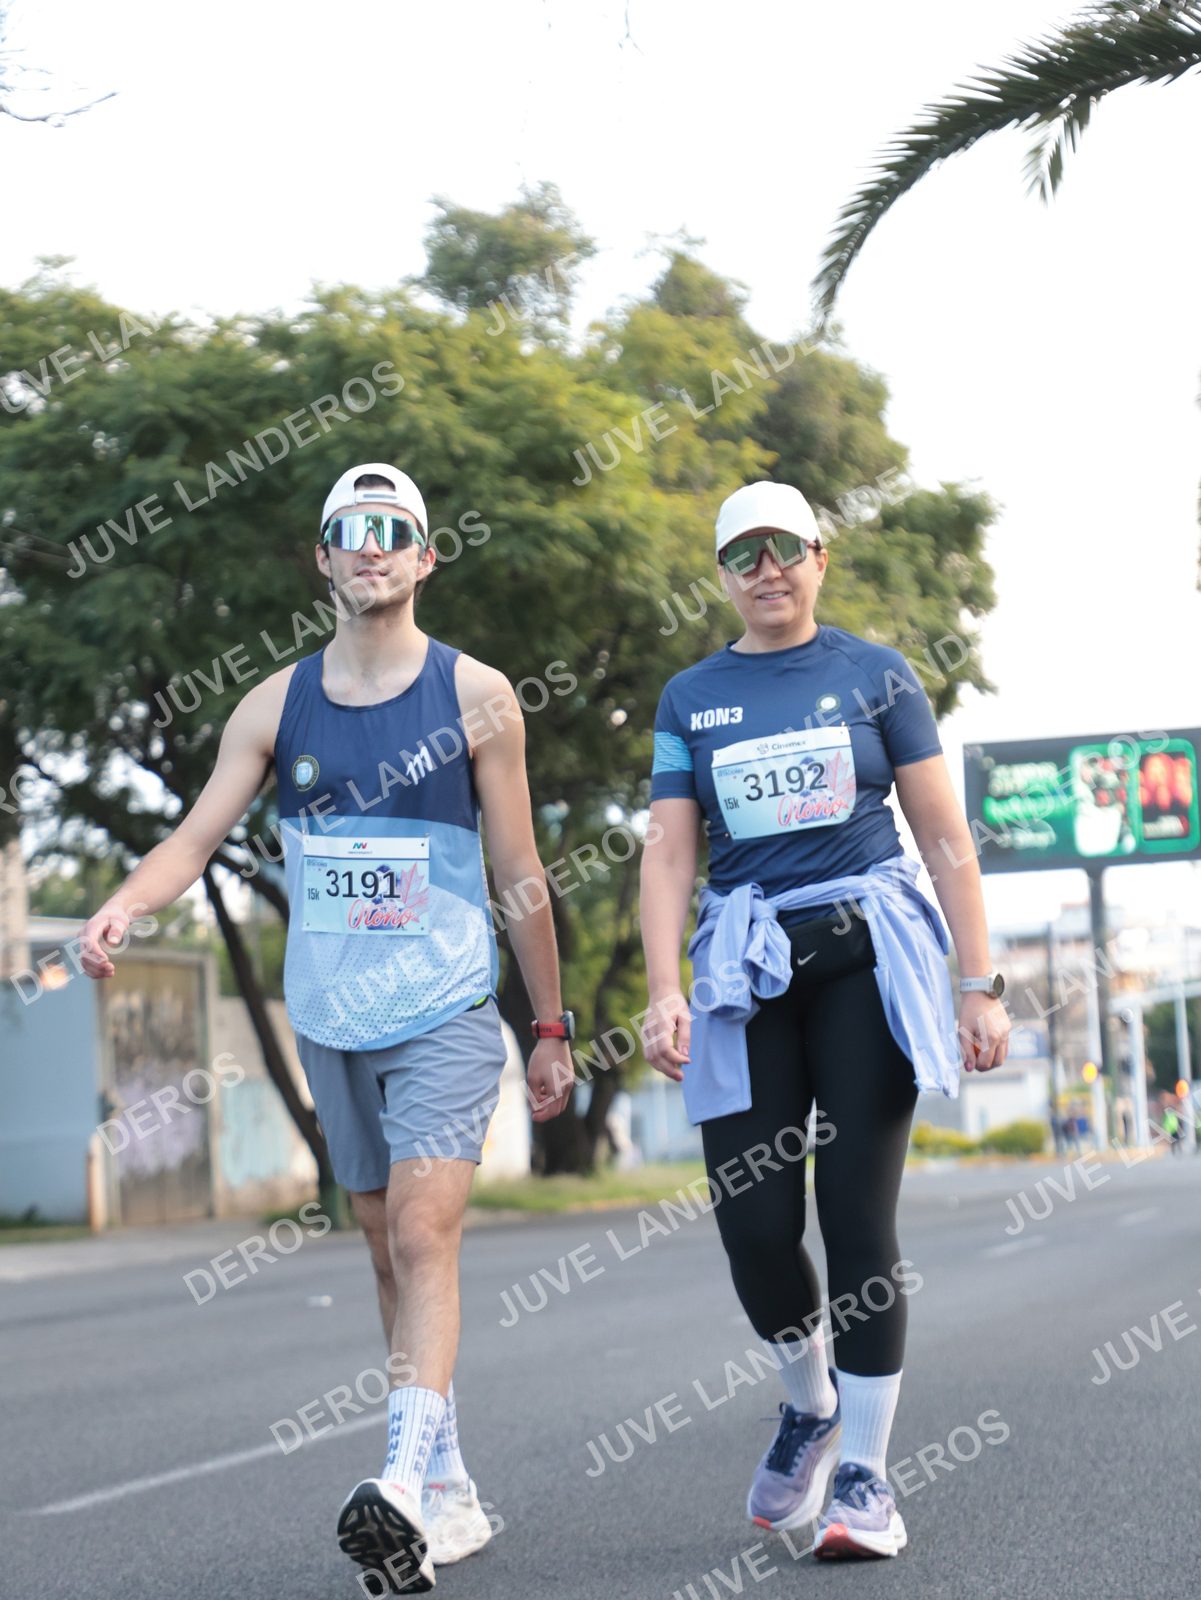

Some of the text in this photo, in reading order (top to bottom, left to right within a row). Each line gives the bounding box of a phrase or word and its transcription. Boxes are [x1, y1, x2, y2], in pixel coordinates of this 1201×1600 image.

[690, 706, 744, 731] KON3
[743, 762, 828, 801] 3192
[724, 797, 740, 811] 15k
[307, 888, 320, 901] 15k
[326, 869, 401, 899] 3191
